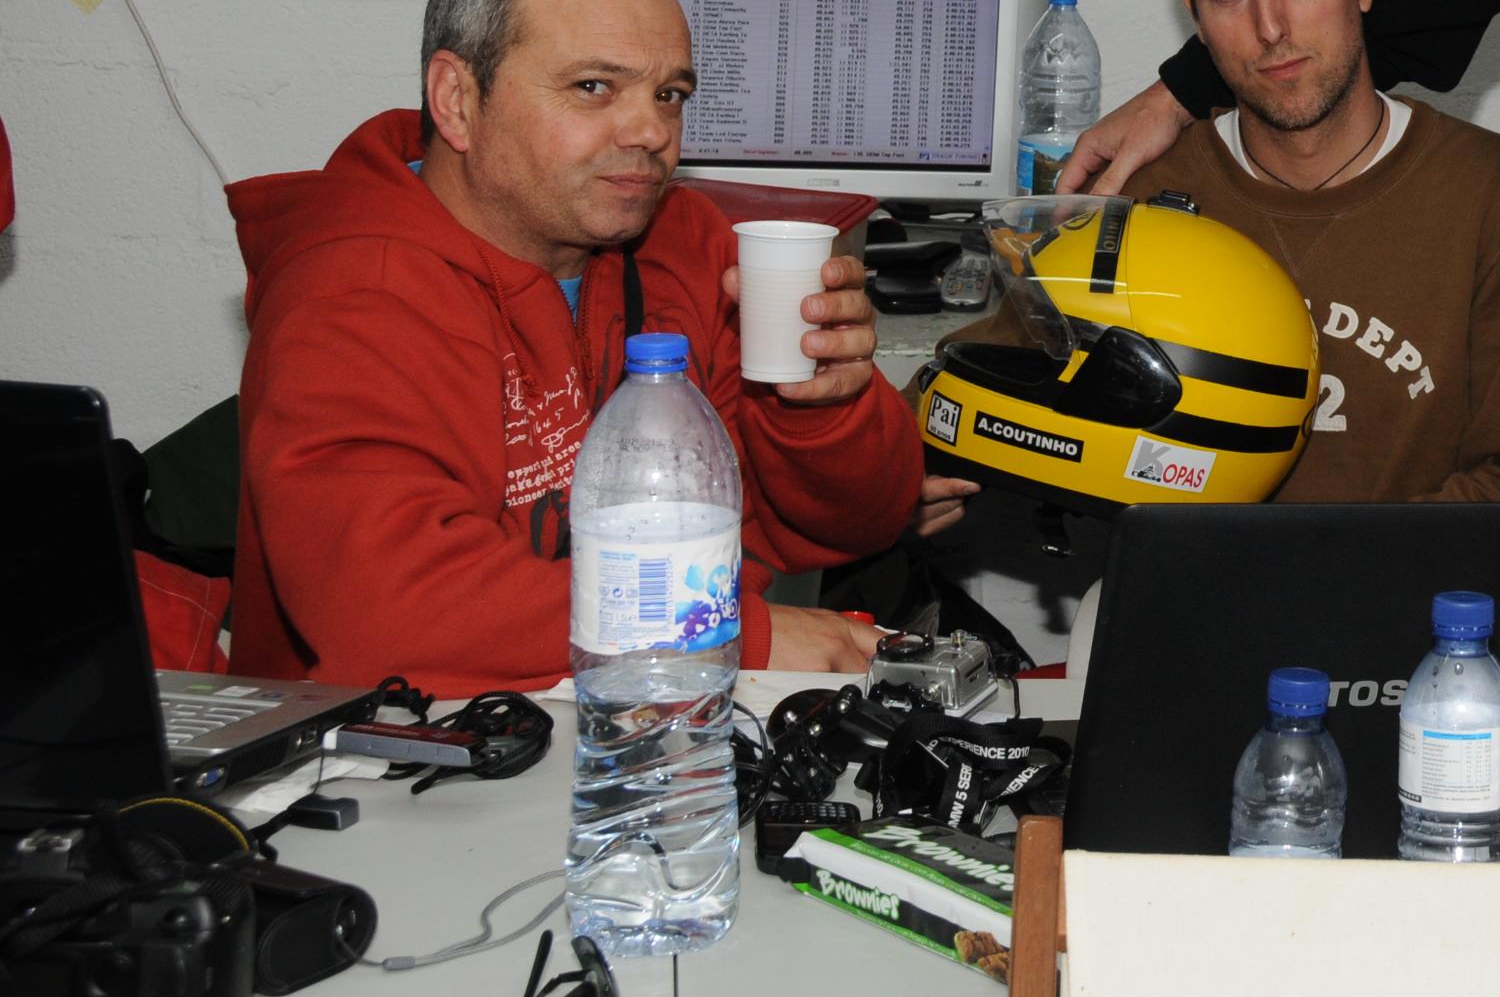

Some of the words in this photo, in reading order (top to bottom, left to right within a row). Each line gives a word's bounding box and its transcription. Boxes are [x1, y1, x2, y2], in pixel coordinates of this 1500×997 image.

[1322, 301, 1436, 400] DEPT
[930, 396, 959, 428] Pai
[1312, 373, 1348, 432] 2
[977, 417, 1079, 457] A.COUTINHO
[1162, 463, 1206, 488] OPAS
[815, 868, 900, 920] Brownies
